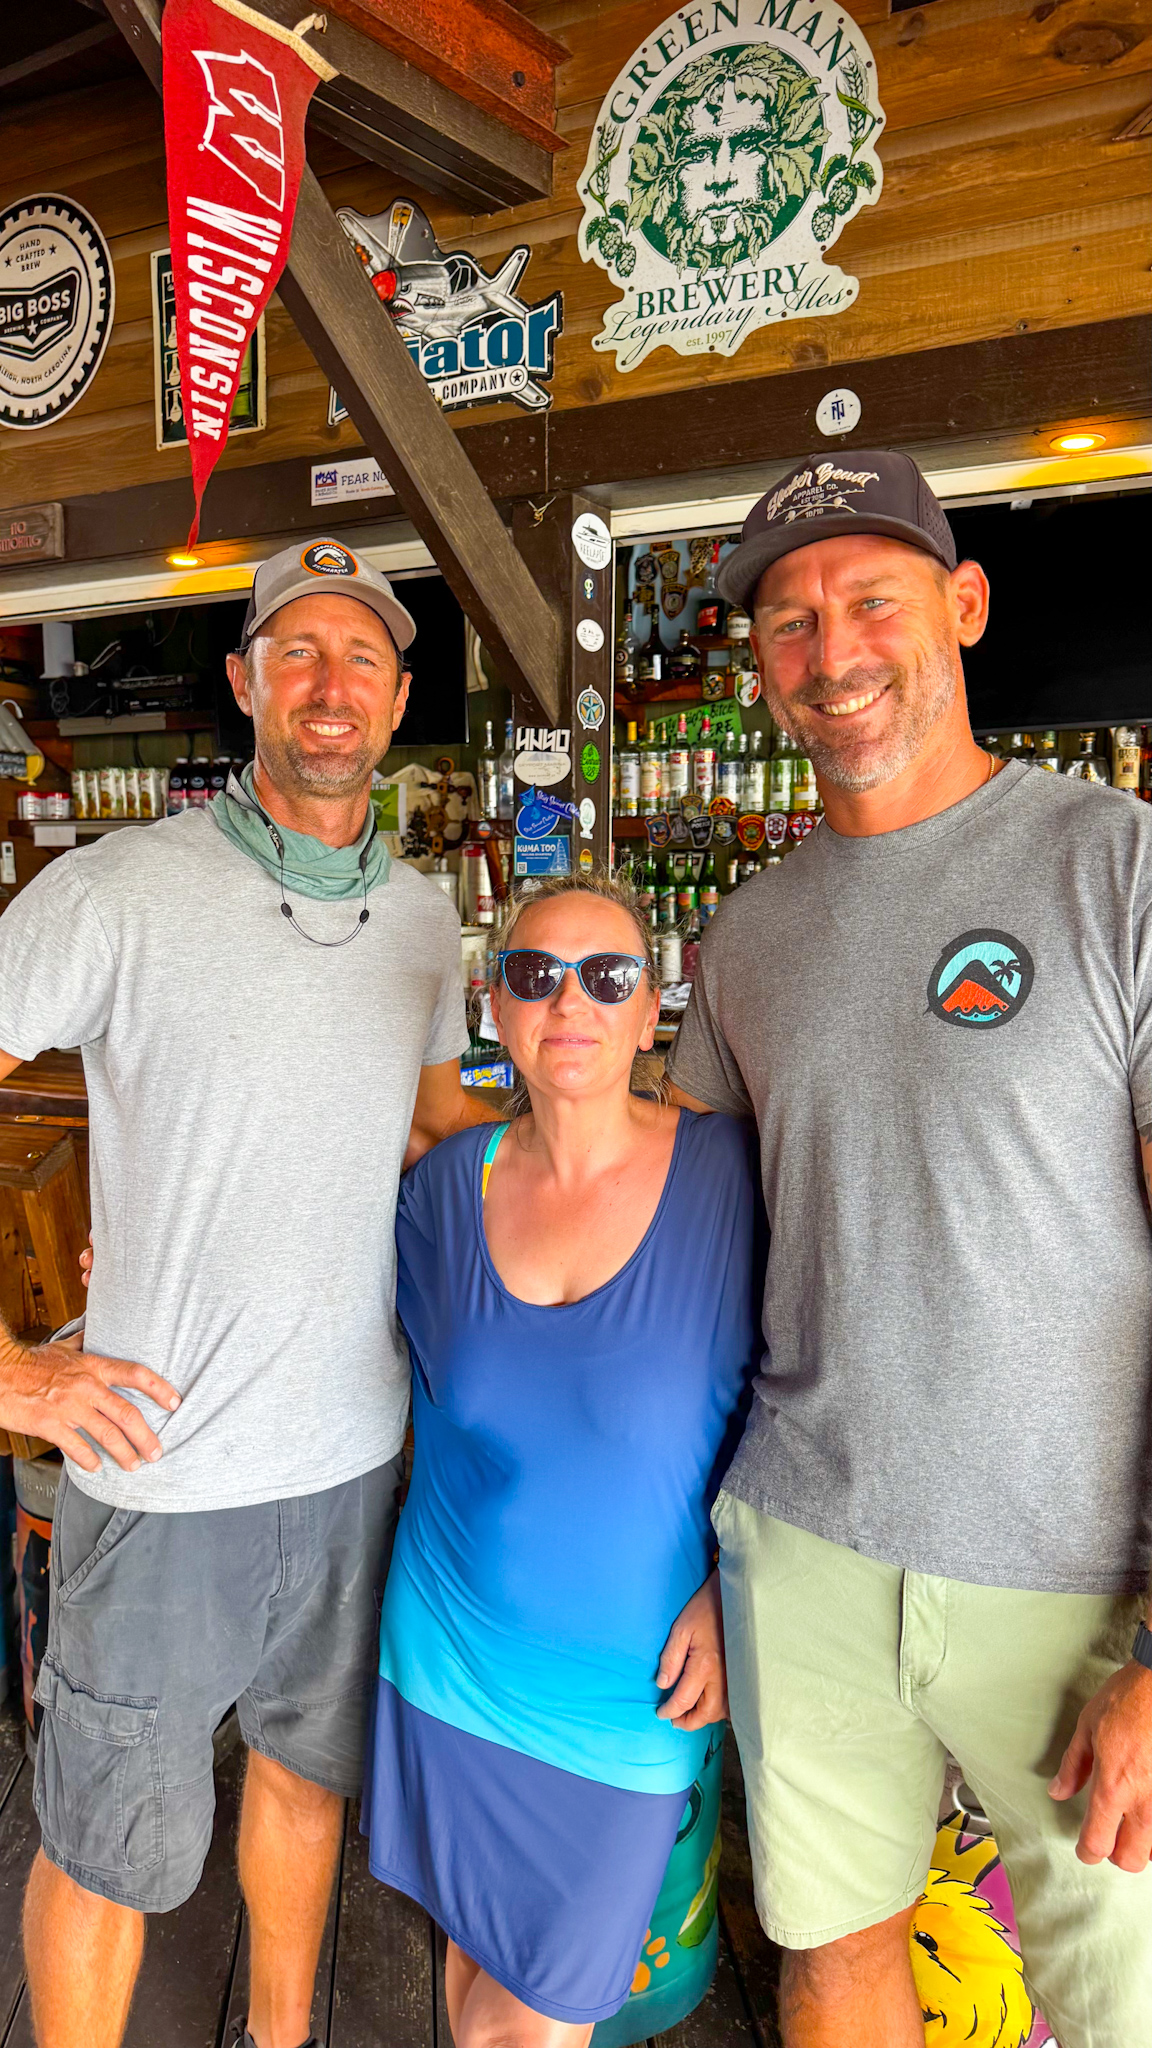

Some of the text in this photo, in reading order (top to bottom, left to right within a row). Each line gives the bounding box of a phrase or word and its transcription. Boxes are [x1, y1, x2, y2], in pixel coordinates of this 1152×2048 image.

[610, 0, 857, 124] GREEN MAN
[19, 239, 41, 251] HAND
[15, 249, 46, 263] CRAFTED
[21, 260, 41, 272] BREW
[635, 262, 810, 319] BREWERY
[0, 289, 71, 325] BIG BOSS
[4, 314, 63, 334] BREWING COMPANY
[187, 196, 283, 441] WISCONSIN
[602, 274, 847, 365] Legendary Ales
[686, 330, 733, 348] est. 1997
[21, 374, 43, 385] NORTH
[44, 345, 72, 378] CAROLINA
[442, 372, 508, 400] COMPANY
[341, 472, 370, 486] FEAR
[792, 483, 839, 502] APPAREL CO.
[517, 844, 556, 852] KUMA TOO
